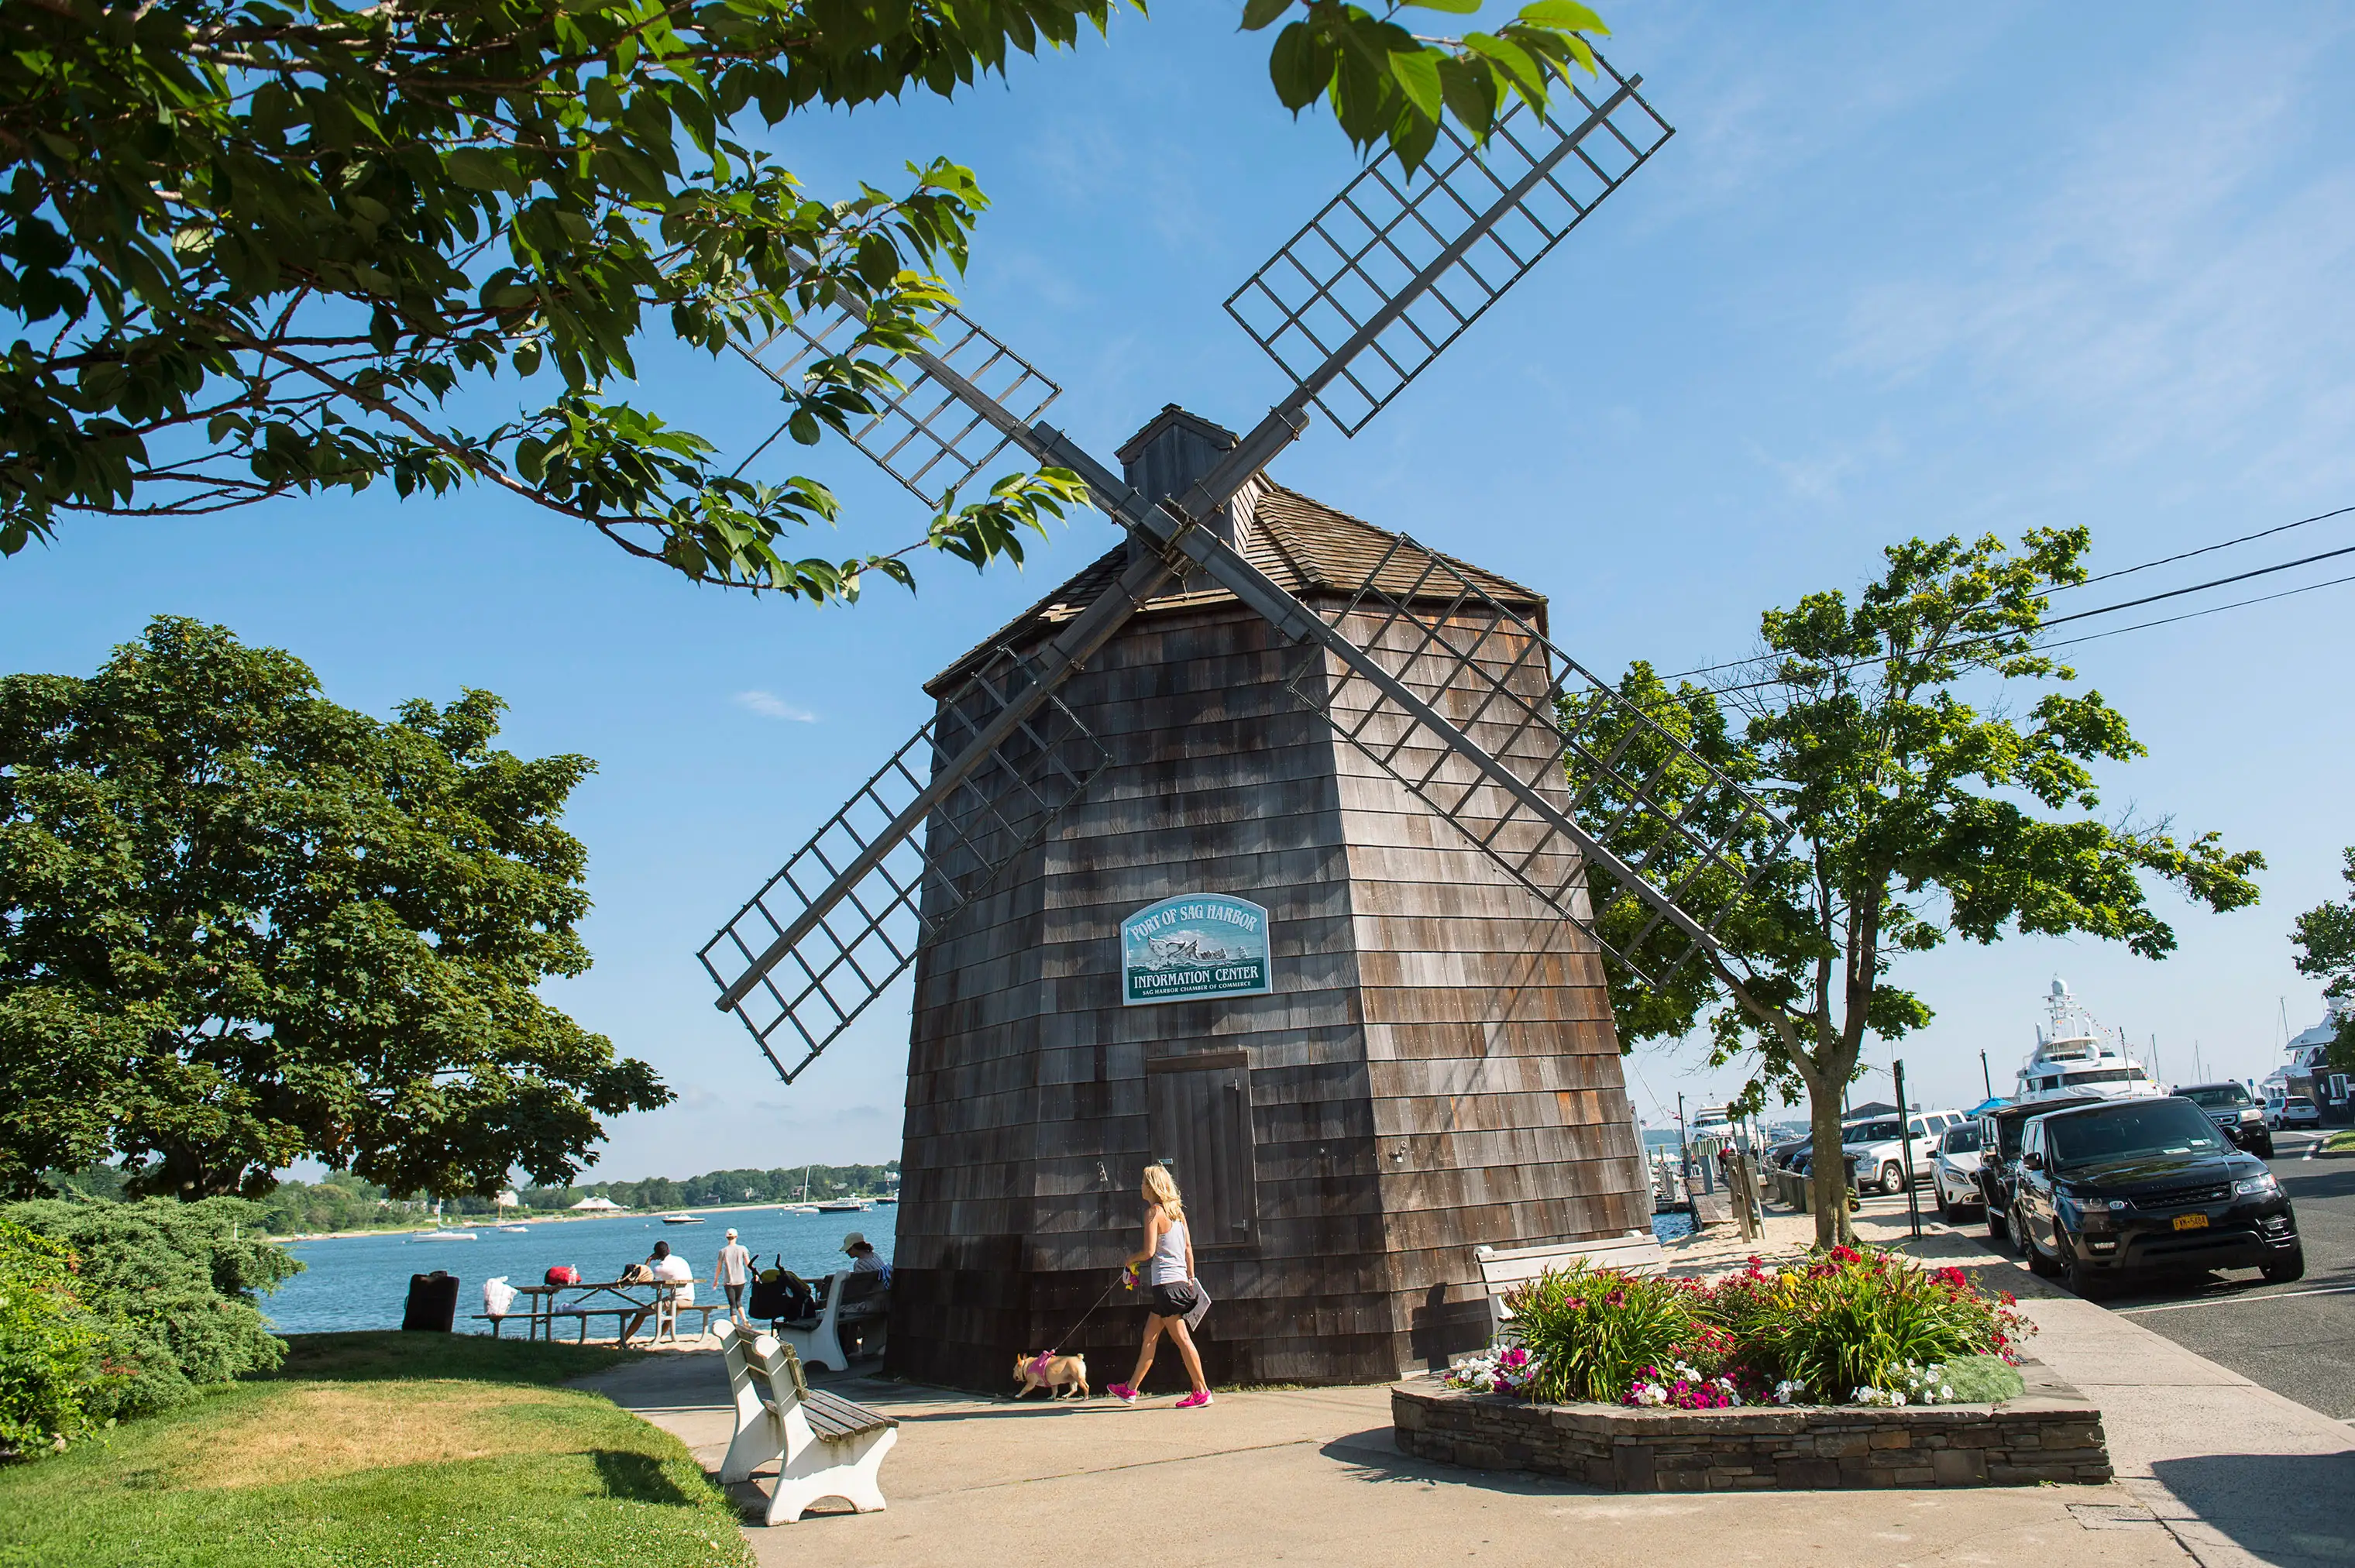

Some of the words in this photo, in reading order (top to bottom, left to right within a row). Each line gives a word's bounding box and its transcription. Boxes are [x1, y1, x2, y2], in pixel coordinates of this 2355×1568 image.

[1130, 915, 1160, 942] PORT
[1162, 908, 1177, 925] OF
[1180, 905, 1203, 921] SAG
[1206, 905, 1257, 932] HARBOR
[1134, 971, 1210, 989] INFORMATION
[1215, 966, 1259, 982] CENTER
